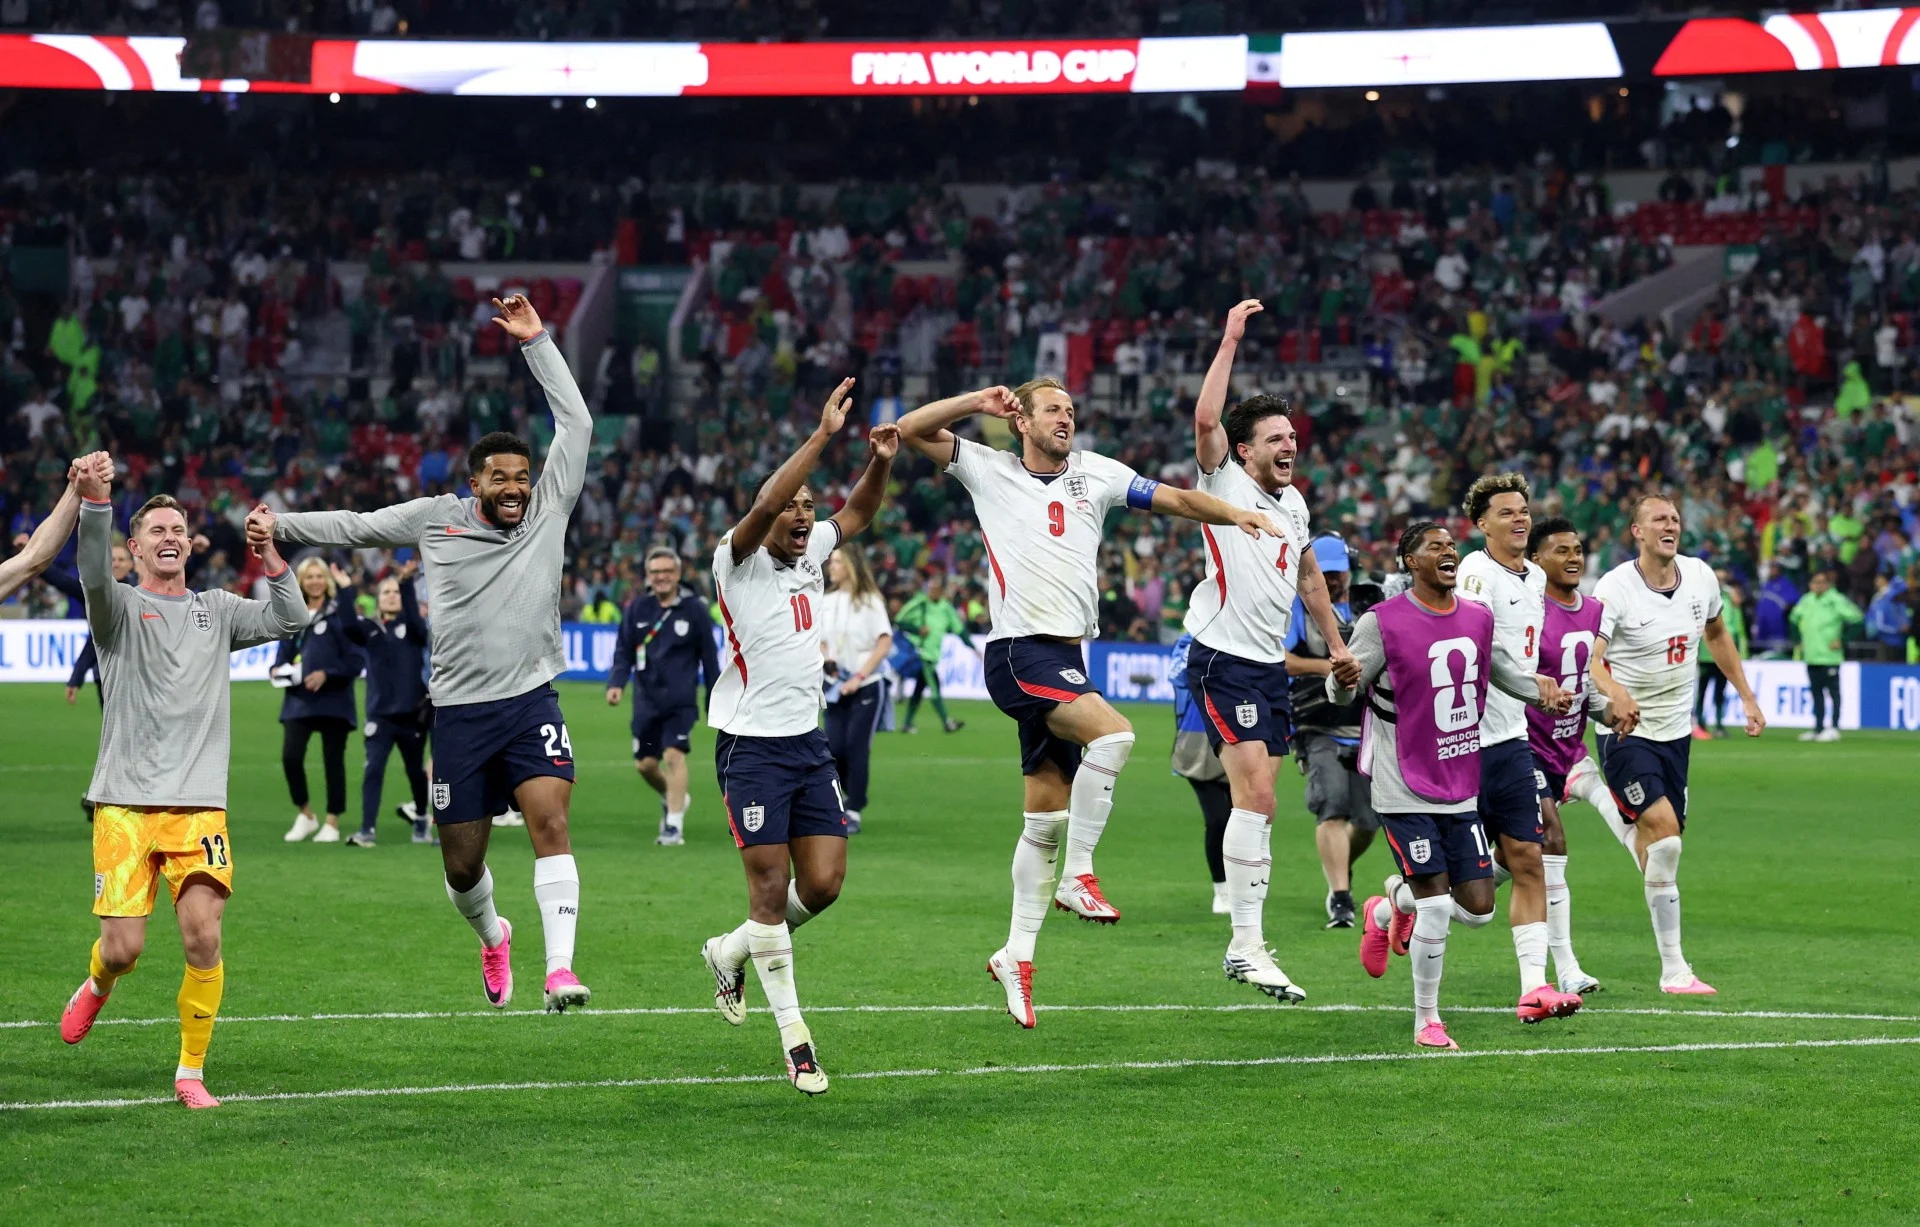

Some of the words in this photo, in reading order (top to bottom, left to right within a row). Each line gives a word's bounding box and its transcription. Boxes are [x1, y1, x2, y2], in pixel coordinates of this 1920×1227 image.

[852, 52, 931, 85] FIFA
[930, 50, 1061, 84] WORLD
[1062, 49, 1137, 82] CUP
[1048, 501, 1065, 537] 9
[1276, 543, 1288, 577] 4
[790, 593, 812, 633] 10
[27, 633, 89, 668] UNI
[1524, 625, 1534, 657] 3
[1667, 635, 1688, 664] 15
[1450, 710, 1468, 724] FIFA
[540, 723, 573, 757] 24
[1436, 733, 1465, 747] WORLD
[1465, 730, 1480, 740] CUP
[1437, 739, 1480, 760] 2026
[200, 834, 227, 866] 13
[558, 906, 576, 916] ENG
